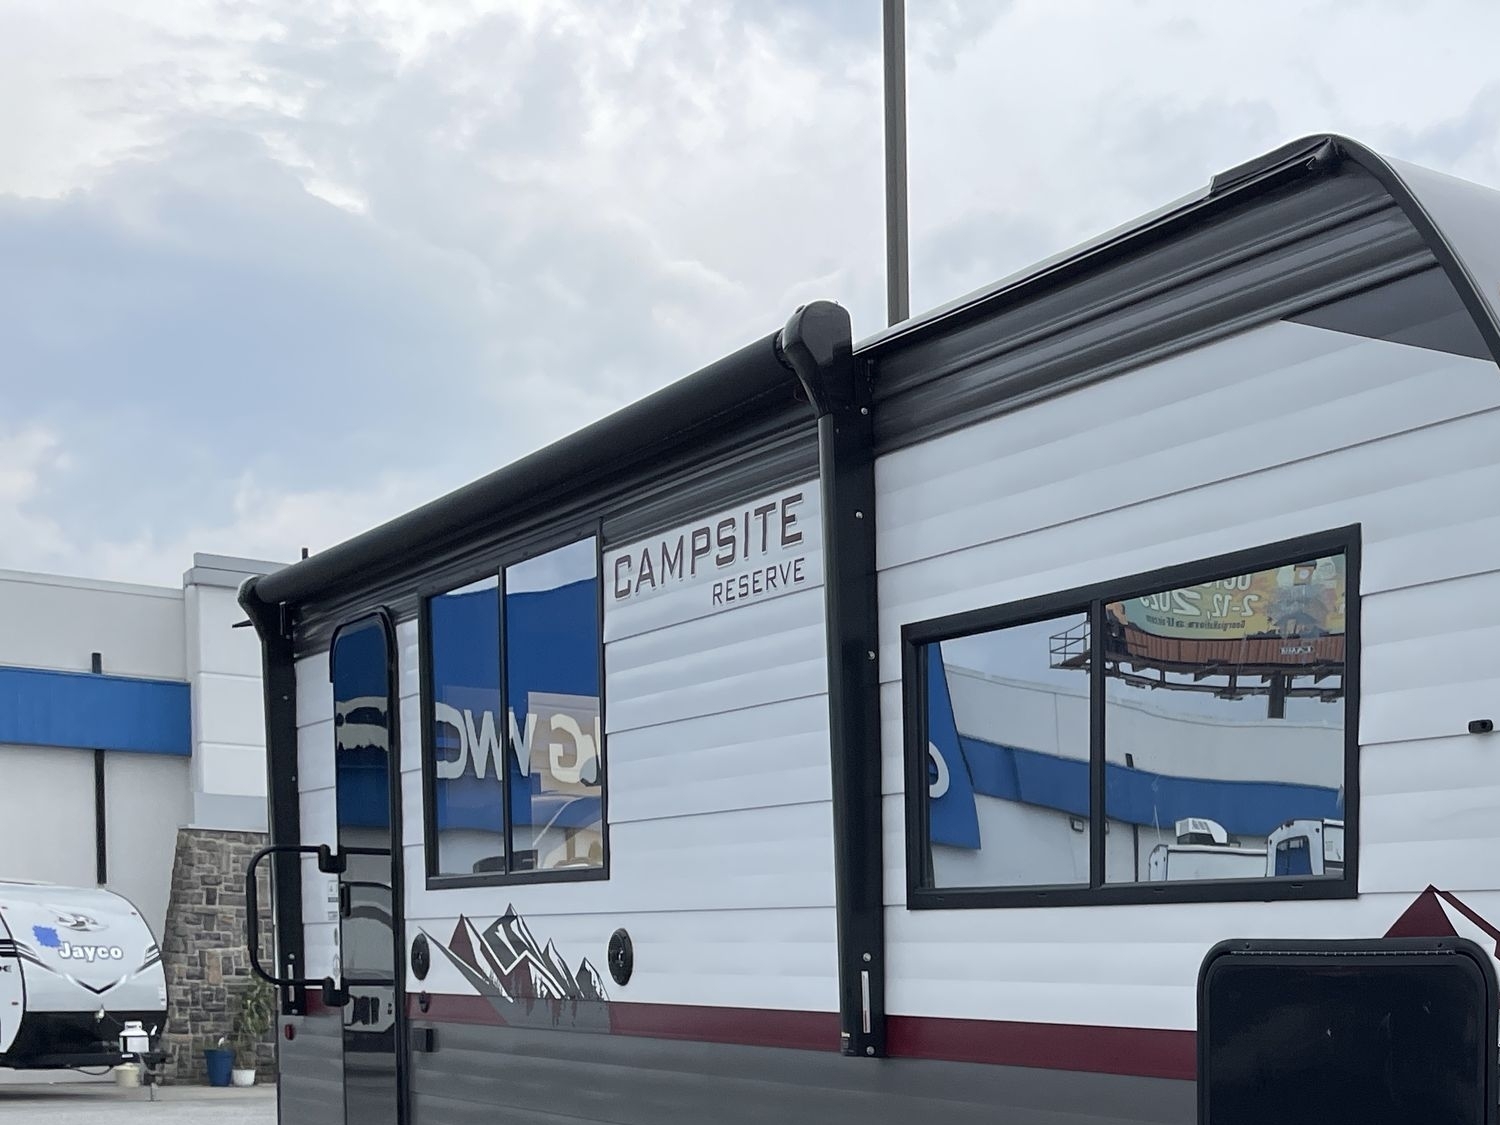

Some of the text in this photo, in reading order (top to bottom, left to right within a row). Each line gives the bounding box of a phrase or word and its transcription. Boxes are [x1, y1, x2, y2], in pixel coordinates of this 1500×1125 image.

[613, 492, 804, 600] CAMPSITE
[711, 557, 806, 606] RESERVE
[58, 941, 123, 962] Jayco
